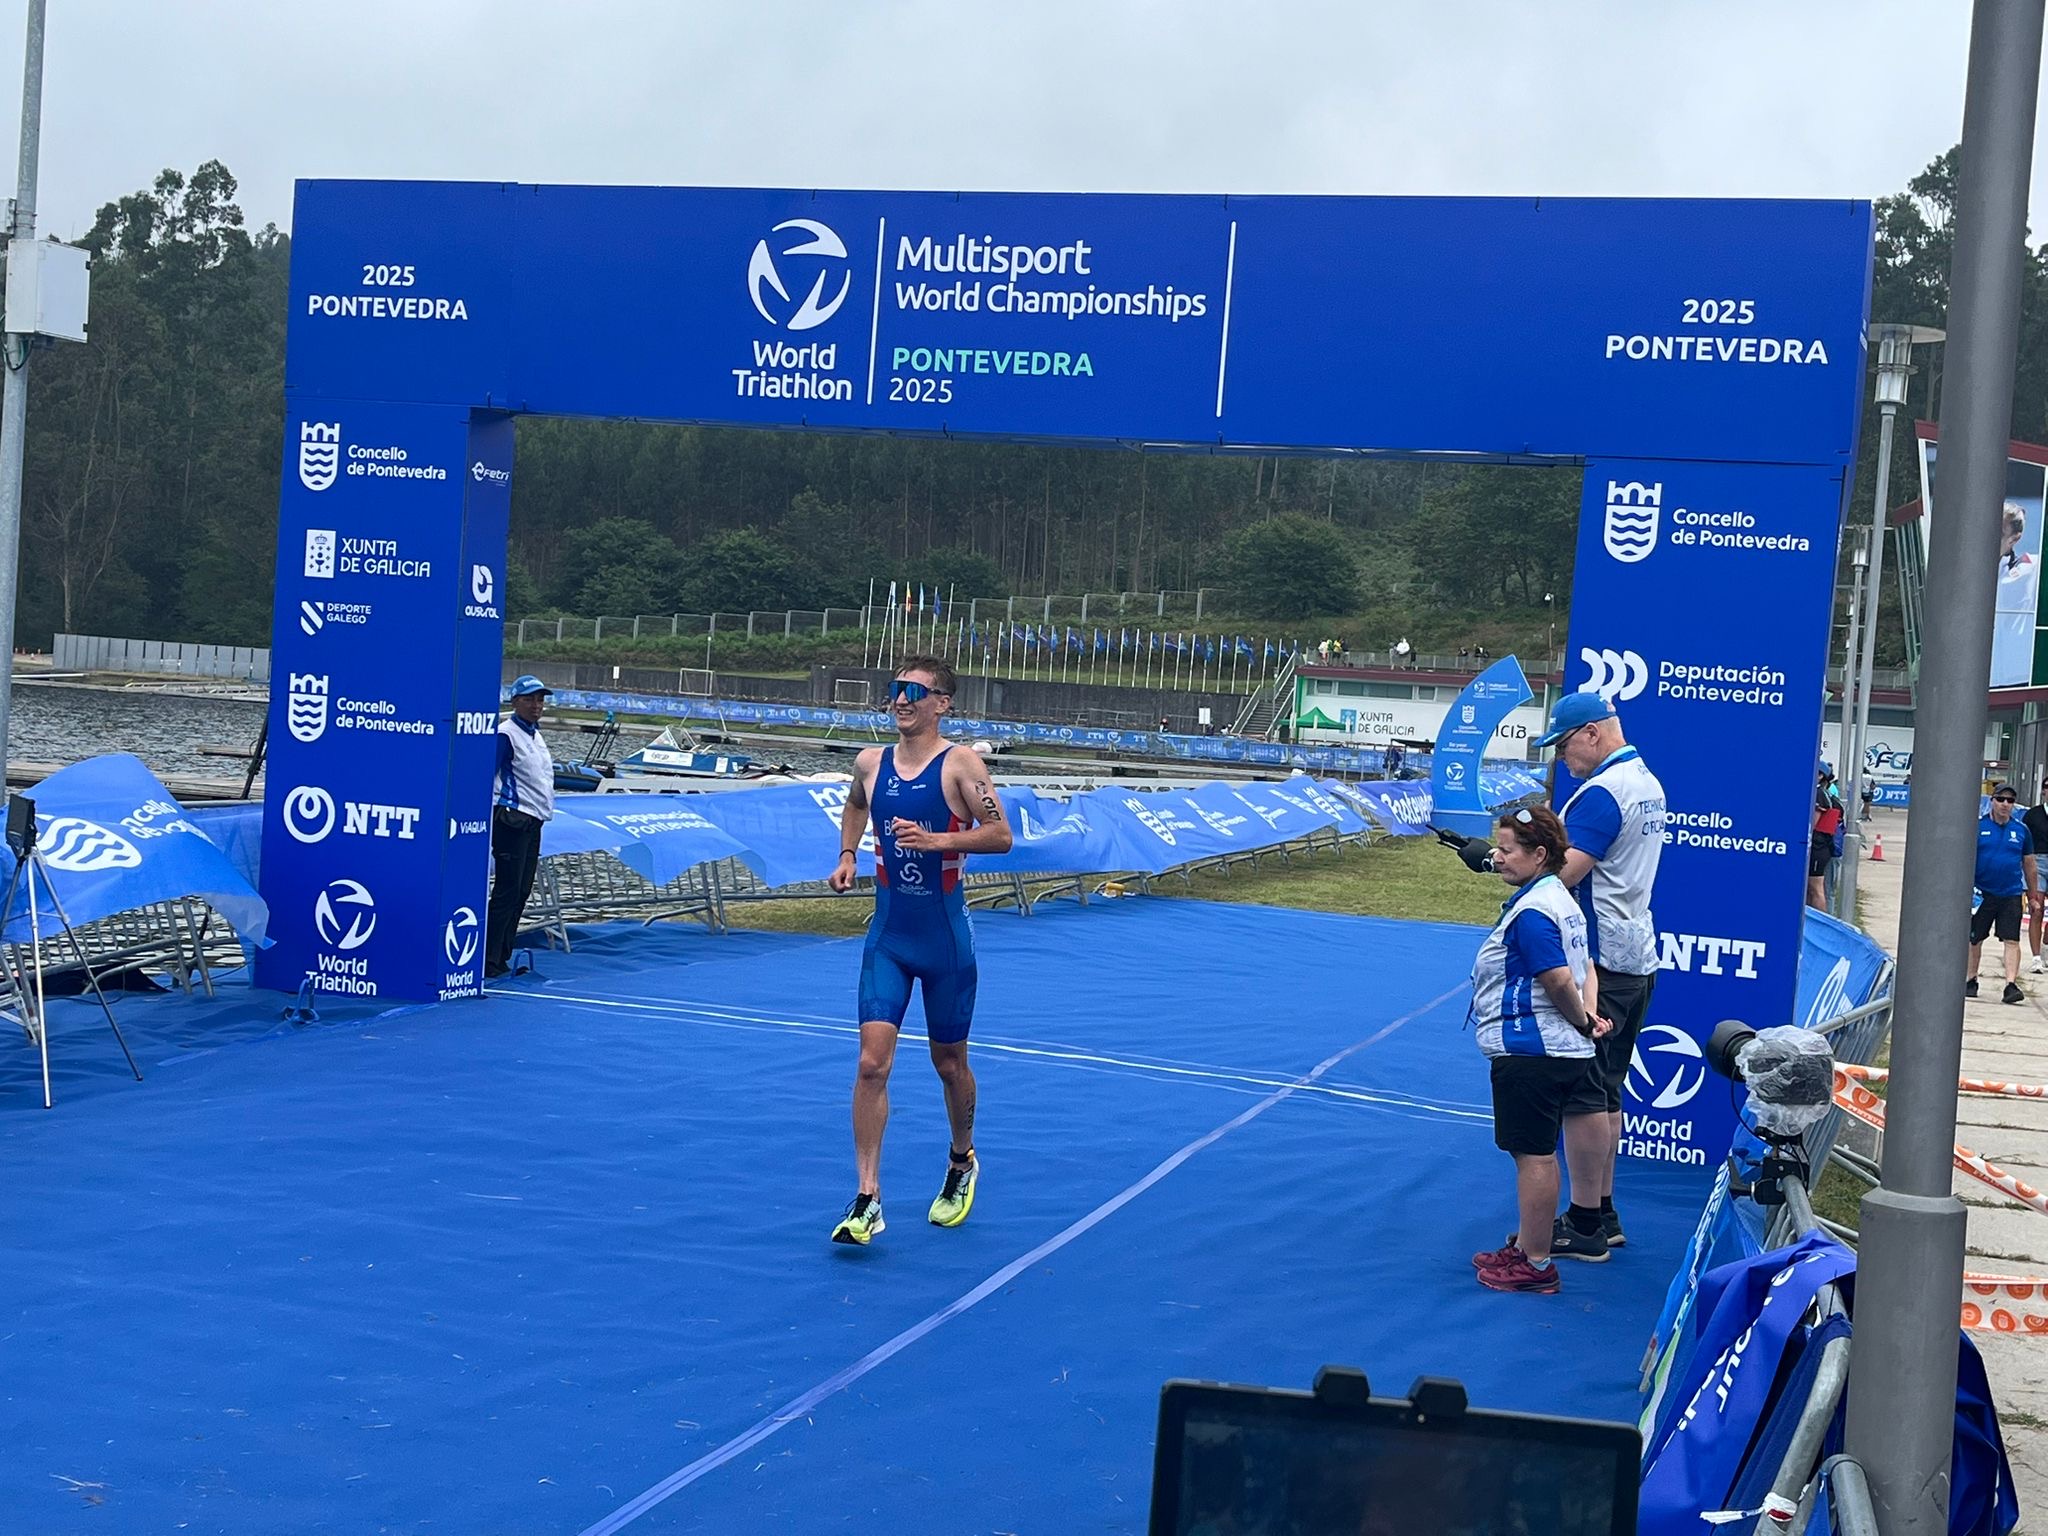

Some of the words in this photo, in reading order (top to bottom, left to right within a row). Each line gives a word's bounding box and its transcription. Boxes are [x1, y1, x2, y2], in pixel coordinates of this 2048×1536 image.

[897, 234, 1091, 281] Multisport
[362, 265, 415, 286] 2025
[308, 295, 468, 320] PONTEVEDRA
[896, 282, 980, 311] World
[987, 283, 1206, 322] Championships
[1682, 299, 1755, 325] 2025
[753, 340, 836, 370] World
[892, 347, 1094, 377] PONTEVEDRA
[1605, 335, 1829, 365] PONTEVEDRA
[732, 369, 852, 400] Triathlon
[889, 378, 953, 403] 2025
[348, 444, 407, 461] Concello
[347, 461, 366, 476] de
[368, 462, 446, 480] Pontevedra
[1673, 508, 1755, 528] Concello
[341, 537, 397, 557] XUNTA
[1671, 529, 1696, 545] de
[1699, 529, 1810, 552] Pontevedra
[339, 556, 360, 573] DE
[364, 558, 431, 578] GALICIA
[326, 602, 372, 615] DEPORTE
[326, 612, 367, 625] GALEGO
[1659, 661, 1785, 686] Deputación
[1657, 680, 1784, 706] Pontevedra
[336, 697, 396, 715] Concello
[1359, 711, 1393, 722] XUNTA
[335, 713, 354, 728] de
[356, 715, 434, 735] Pontevedra
[456, 712, 496, 735] FROIZ
[1358, 723, 1370, 733] DE
[1373, 724, 1415, 735] GALICIA
[1885, 790, 1907, 800] NTT
[120, 799, 178, 827] ncello
[343, 802, 420, 839] NTT
[1664, 811, 1733, 830] oncello
[1677, 829, 1787, 855] Pontevedra
[318, 953, 368, 976] World
[1659, 931, 1766, 979] NTT
[305, 971, 377, 996] Triathlon
[446, 970, 473, 987] World
[1623, 1112, 1692, 1141] World
[1617, 1135, 1706, 1166] riathlon
